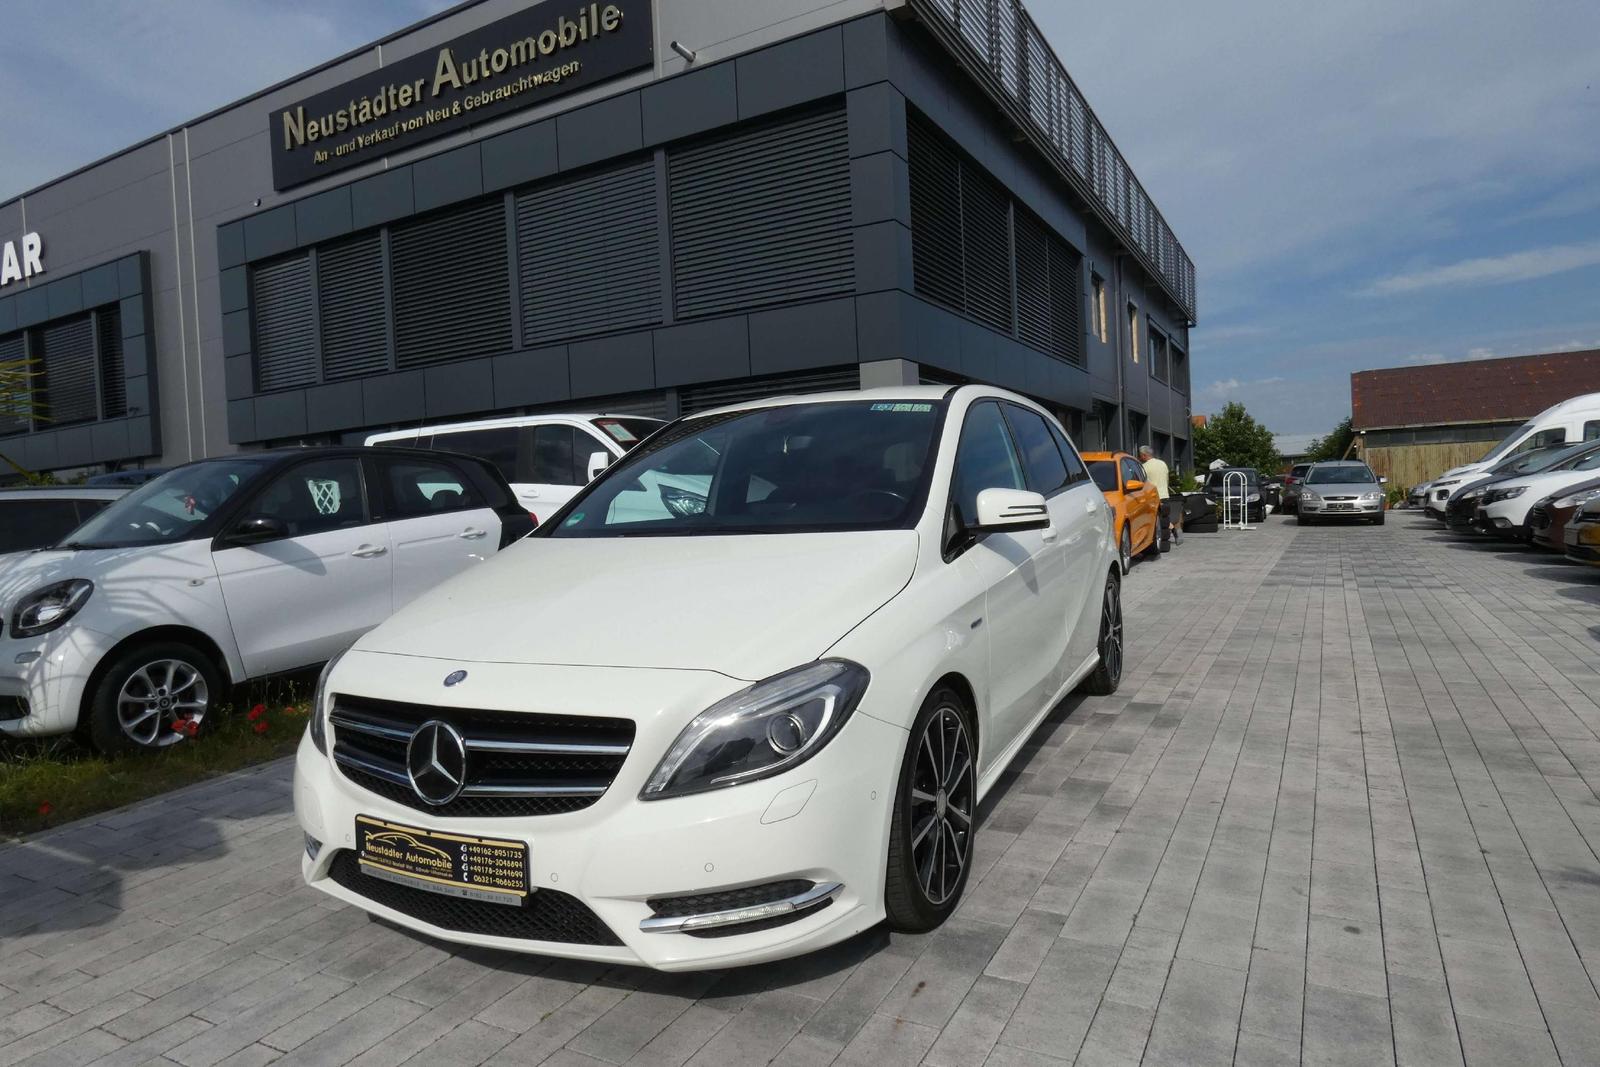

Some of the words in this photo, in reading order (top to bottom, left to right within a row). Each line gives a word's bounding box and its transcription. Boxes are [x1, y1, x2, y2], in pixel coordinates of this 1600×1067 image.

[283, 78, 424, 150] Neustädter
[431, 3, 622, 96] Automobile
[314, 151, 328, 164] An
[336, 138, 356, 156] und
[357, 121, 400, 149] Verkauf
[401, 116, 423, 133] von
[425, 107, 450, 125] Neu
[452, 100, 462, 116] &
[464, 60, 580, 111] Gebrauchtwagen
[1, 231, 43, 285] AR
[406, 852, 453, 869] Automobile
